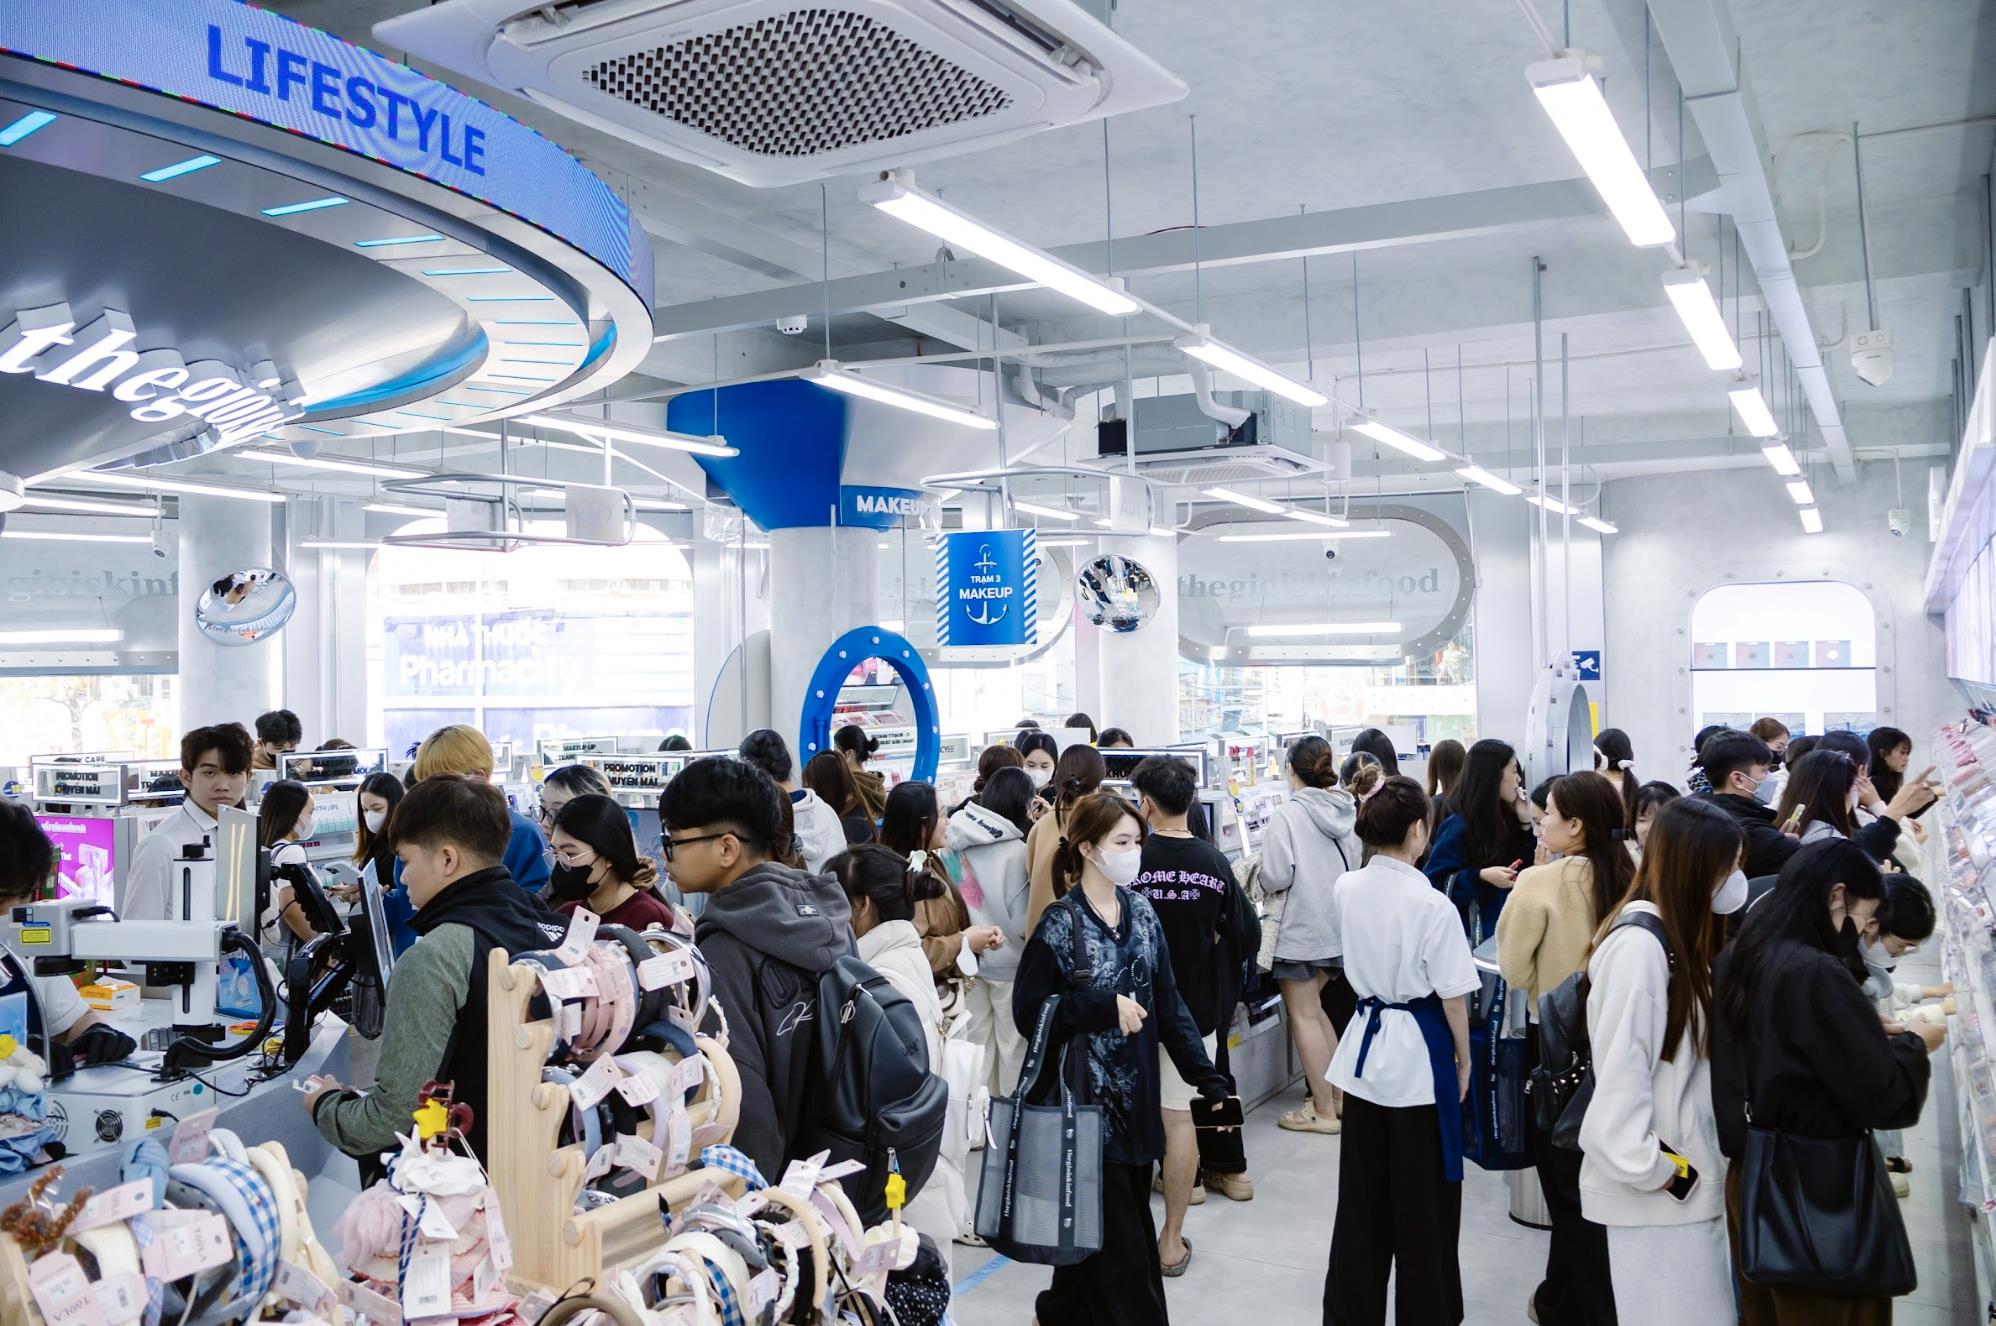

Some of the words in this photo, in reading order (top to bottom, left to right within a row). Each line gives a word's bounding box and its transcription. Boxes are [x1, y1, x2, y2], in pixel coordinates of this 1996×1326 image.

[207, 24, 486, 176] LIFESTYLE
[970, 575, 995, 584] TRẠM
[995, 574, 1002, 582] 3
[1178, 568, 1440, 605] thegioifood
[959, 586, 1013, 600] MAKEUP
[604, 763, 656, 772] PROMOTION
[56, 771, 99, 782] PROMOTION
[1124, 870, 1177, 889] ROME
[537, 922, 565, 932] adidas
